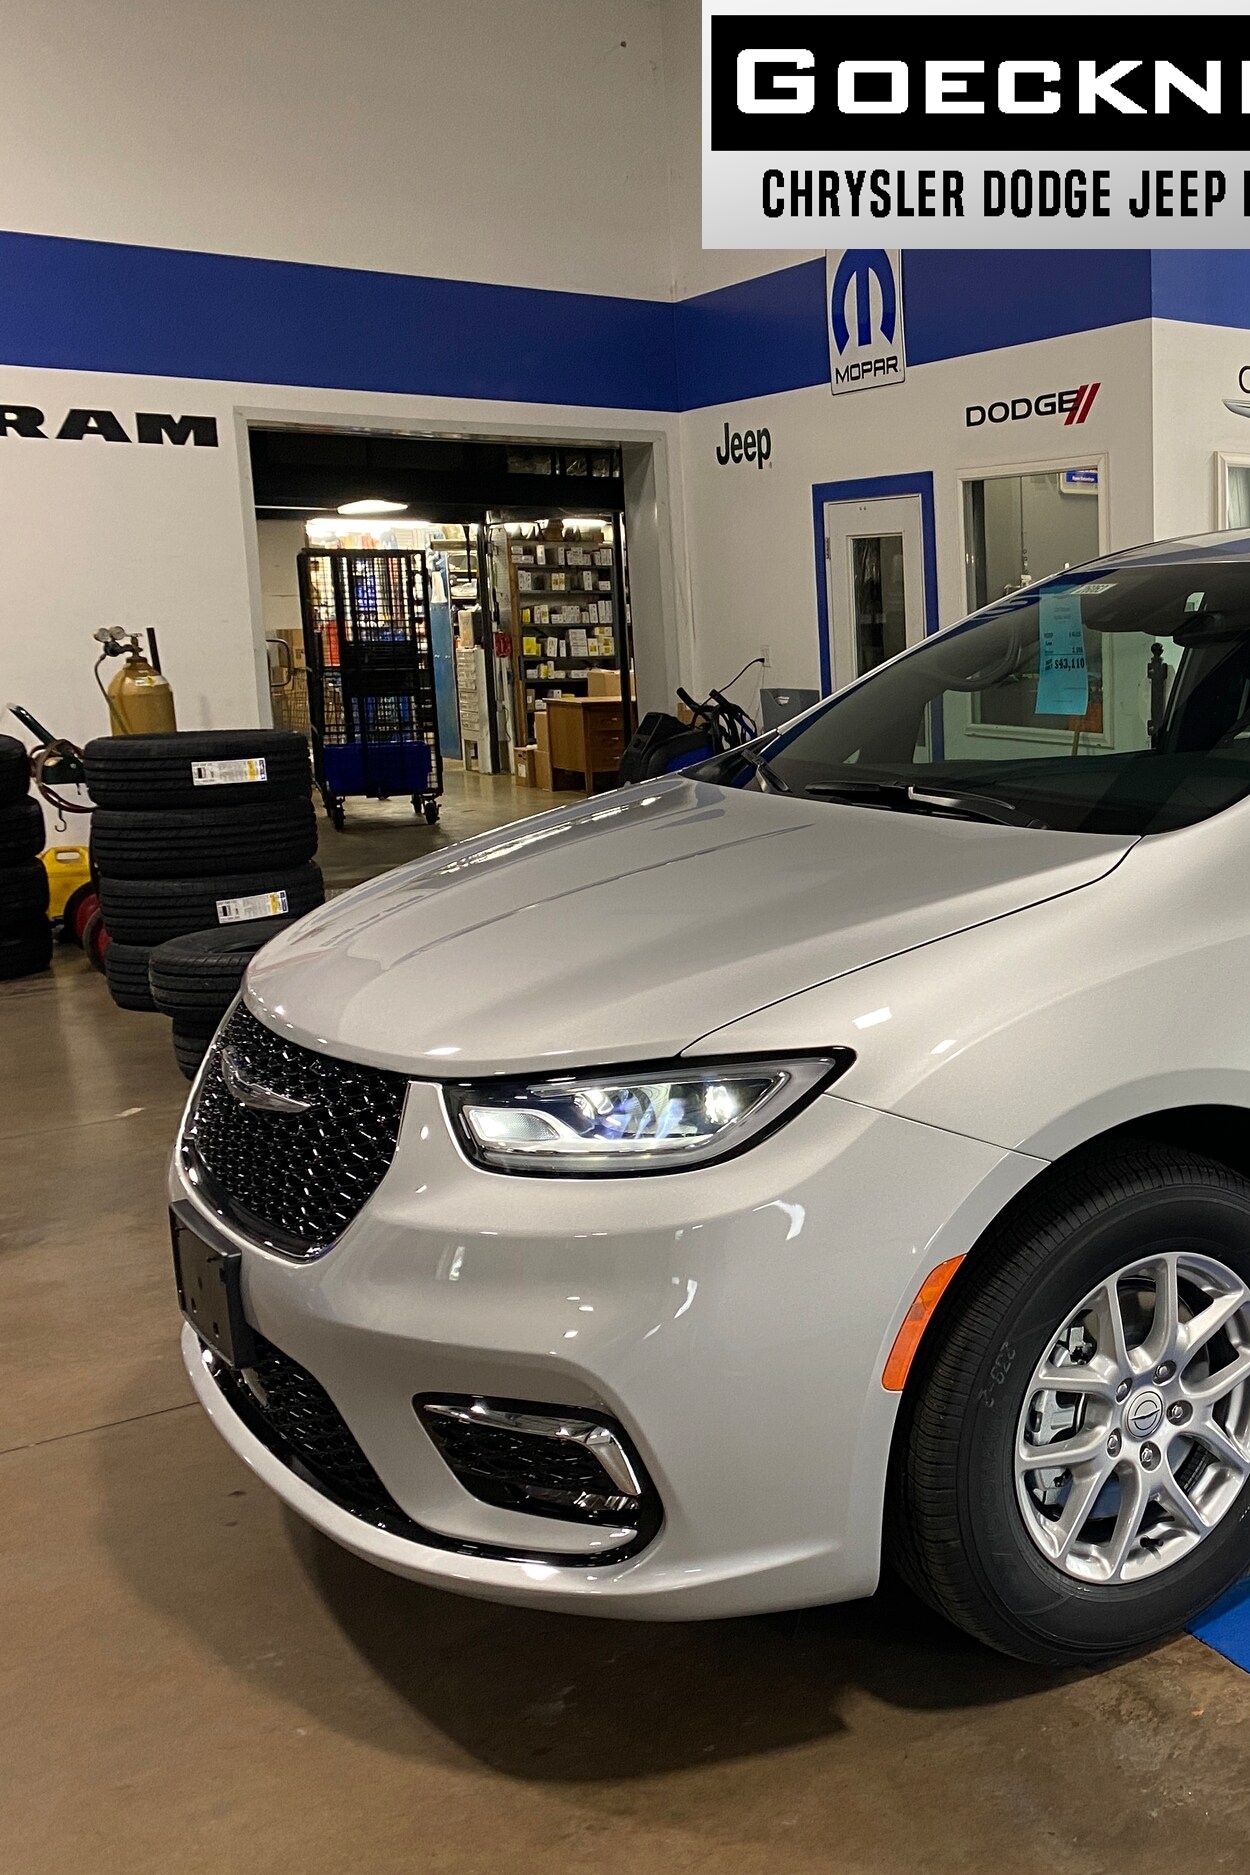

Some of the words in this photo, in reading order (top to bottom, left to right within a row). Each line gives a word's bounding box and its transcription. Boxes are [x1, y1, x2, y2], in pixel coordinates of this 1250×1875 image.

[835, 355, 899, 385] MOPAR
[0, 404, 219, 448] RAM
[966, 389, 1080, 427] DODGE
[716, 422, 771, 470] Jeep
